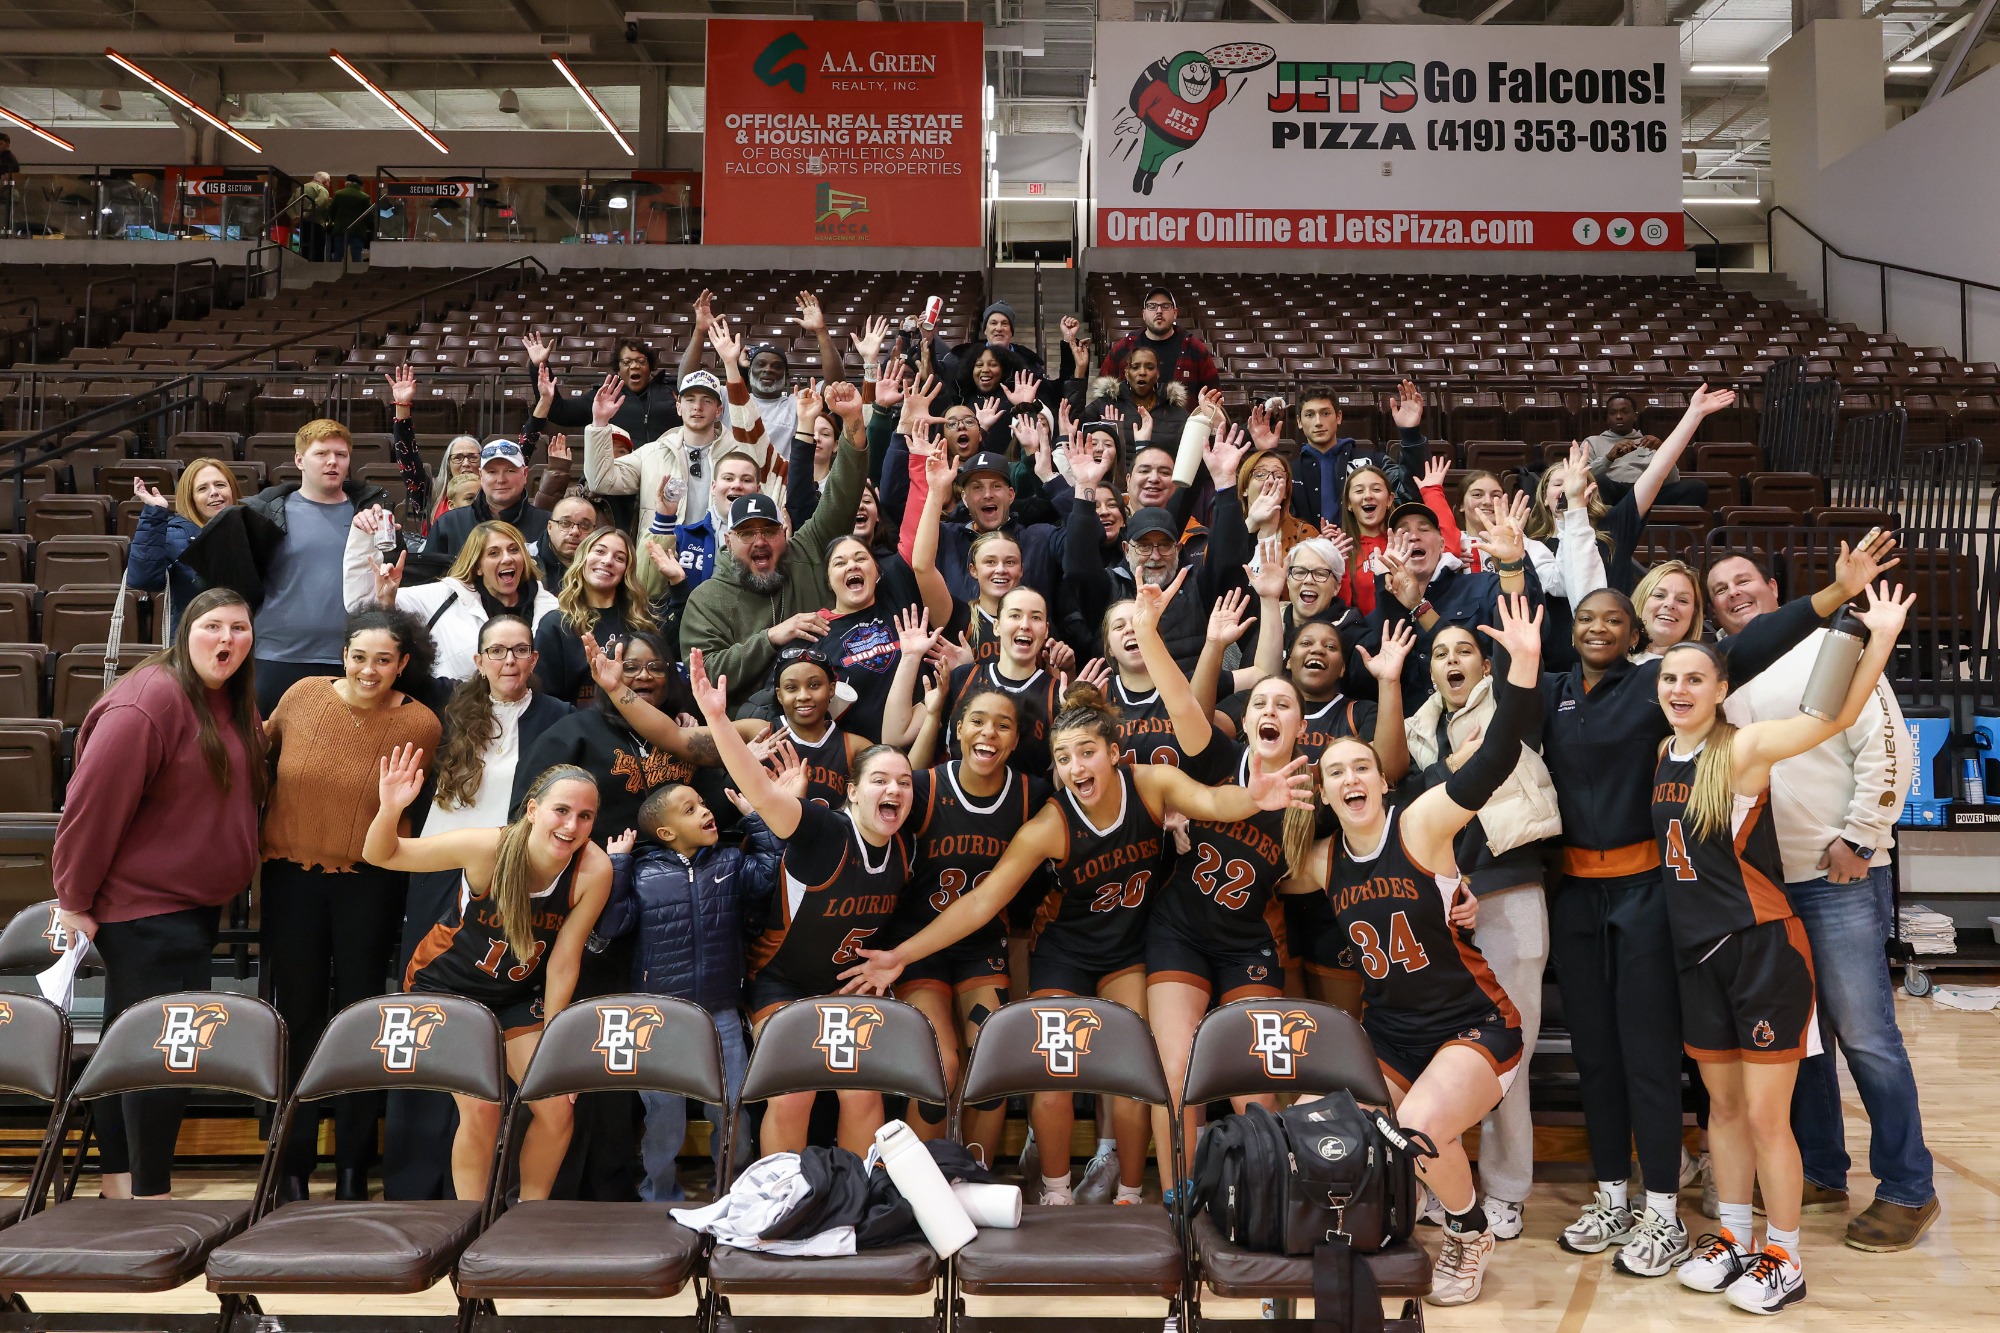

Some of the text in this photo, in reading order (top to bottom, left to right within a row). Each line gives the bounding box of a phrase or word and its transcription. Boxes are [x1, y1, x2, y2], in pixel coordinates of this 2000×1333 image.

[820, 51, 937, 73] A.A. GREEN
[832, 81, 919, 92] REALTY, INC.
[1267, 60, 1418, 113] JET'S
[1424, 61, 1666, 105] Go Falcons!
[725, 114, 963, 129] OFFICIAL REAL ESTATE
[1165, 118, 1193, 136] PIZZA
[1168, 107, 1199, 128] JET'S
[735, 130, 952, 145] & HOUSING PARTNER
[1272, 120, 1416, 150] PIZZA
[1427, 119, 1667, 153] (419) 353-0316
[725, 162, 790, 175] FALCON
[864, 162, 962, 175] PROPERTIES
[742, 148, 945, 160] OF BGSU ATHLETICS AND
[227, 184, 252, 192] SECTION
[410, 186, 434, 194] SECTION
[1030, 184, 1041, 193] EXIT
[815, 223, 869, 234] MECCA
[1107, 211, 1534, 245] Order Online at JetsPizza.com
[977, 453, 989, 466] L
[747, 499, 761, 513] L
[1874, 684, 1898, 788] carhartt
[1910, 723, 1922, 796] POWERADE
[1957, 814, 1984, 823] POWER
[1073, 837, 1159, 885] LOURDES
[1665, 819, 1698, 881] 4
[1090, 869, 1152, 913] 20
[1191, 842, 1256, 910] 22
[1332, 877, 1419, 916] LOURDES
[474, 936, 547, 982] 13
[831, 926, 879, 965] 5
[1348, 910, 1430, 980] 34
[1376, 1116, 1409, 1151] CRAMER
